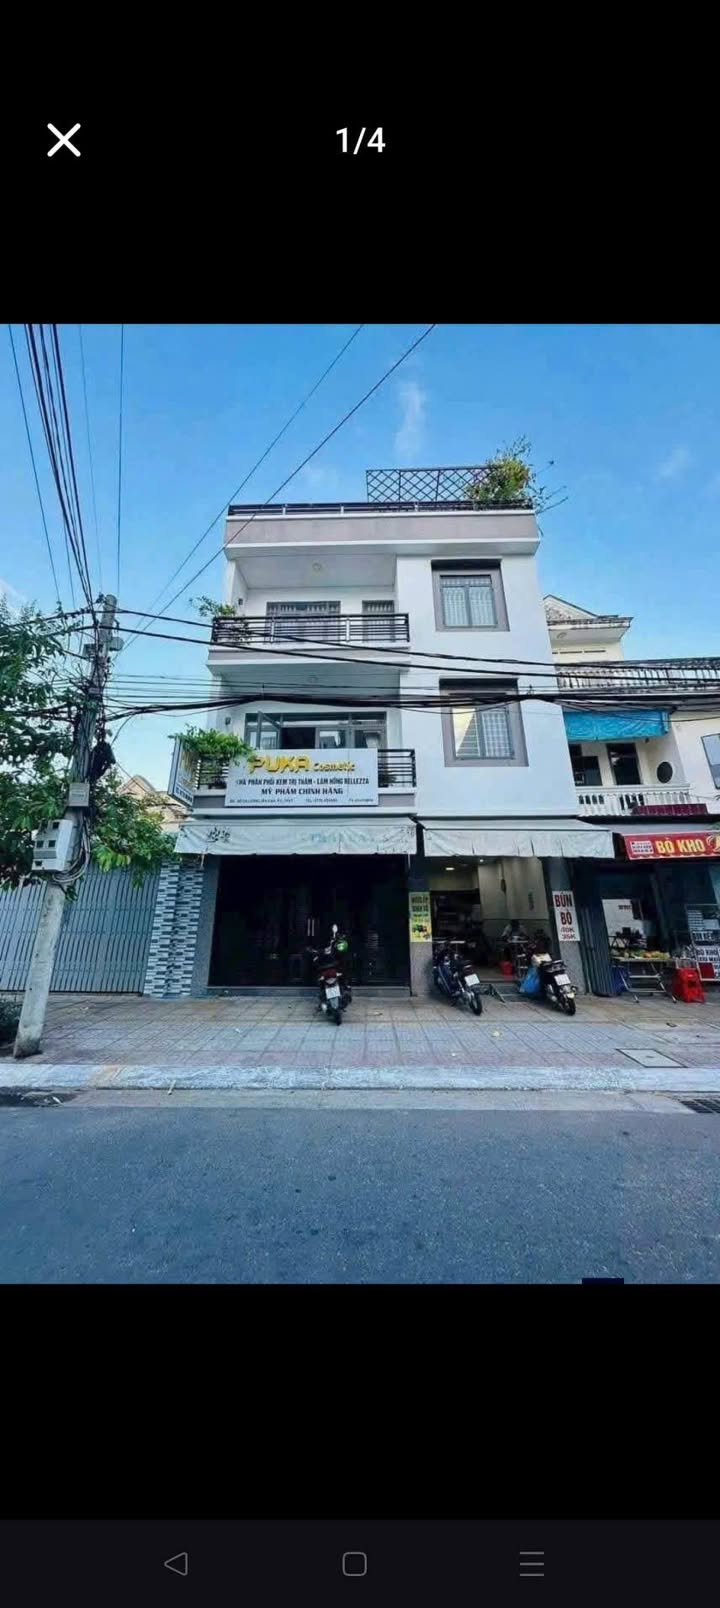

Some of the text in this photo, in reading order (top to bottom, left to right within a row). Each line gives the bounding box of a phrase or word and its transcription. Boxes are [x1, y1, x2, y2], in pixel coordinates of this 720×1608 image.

[313, 761, 355, 772] Cosmetic
[655, 837, 675, 854] BÒ
[676, 838, 706, 853] KHO
